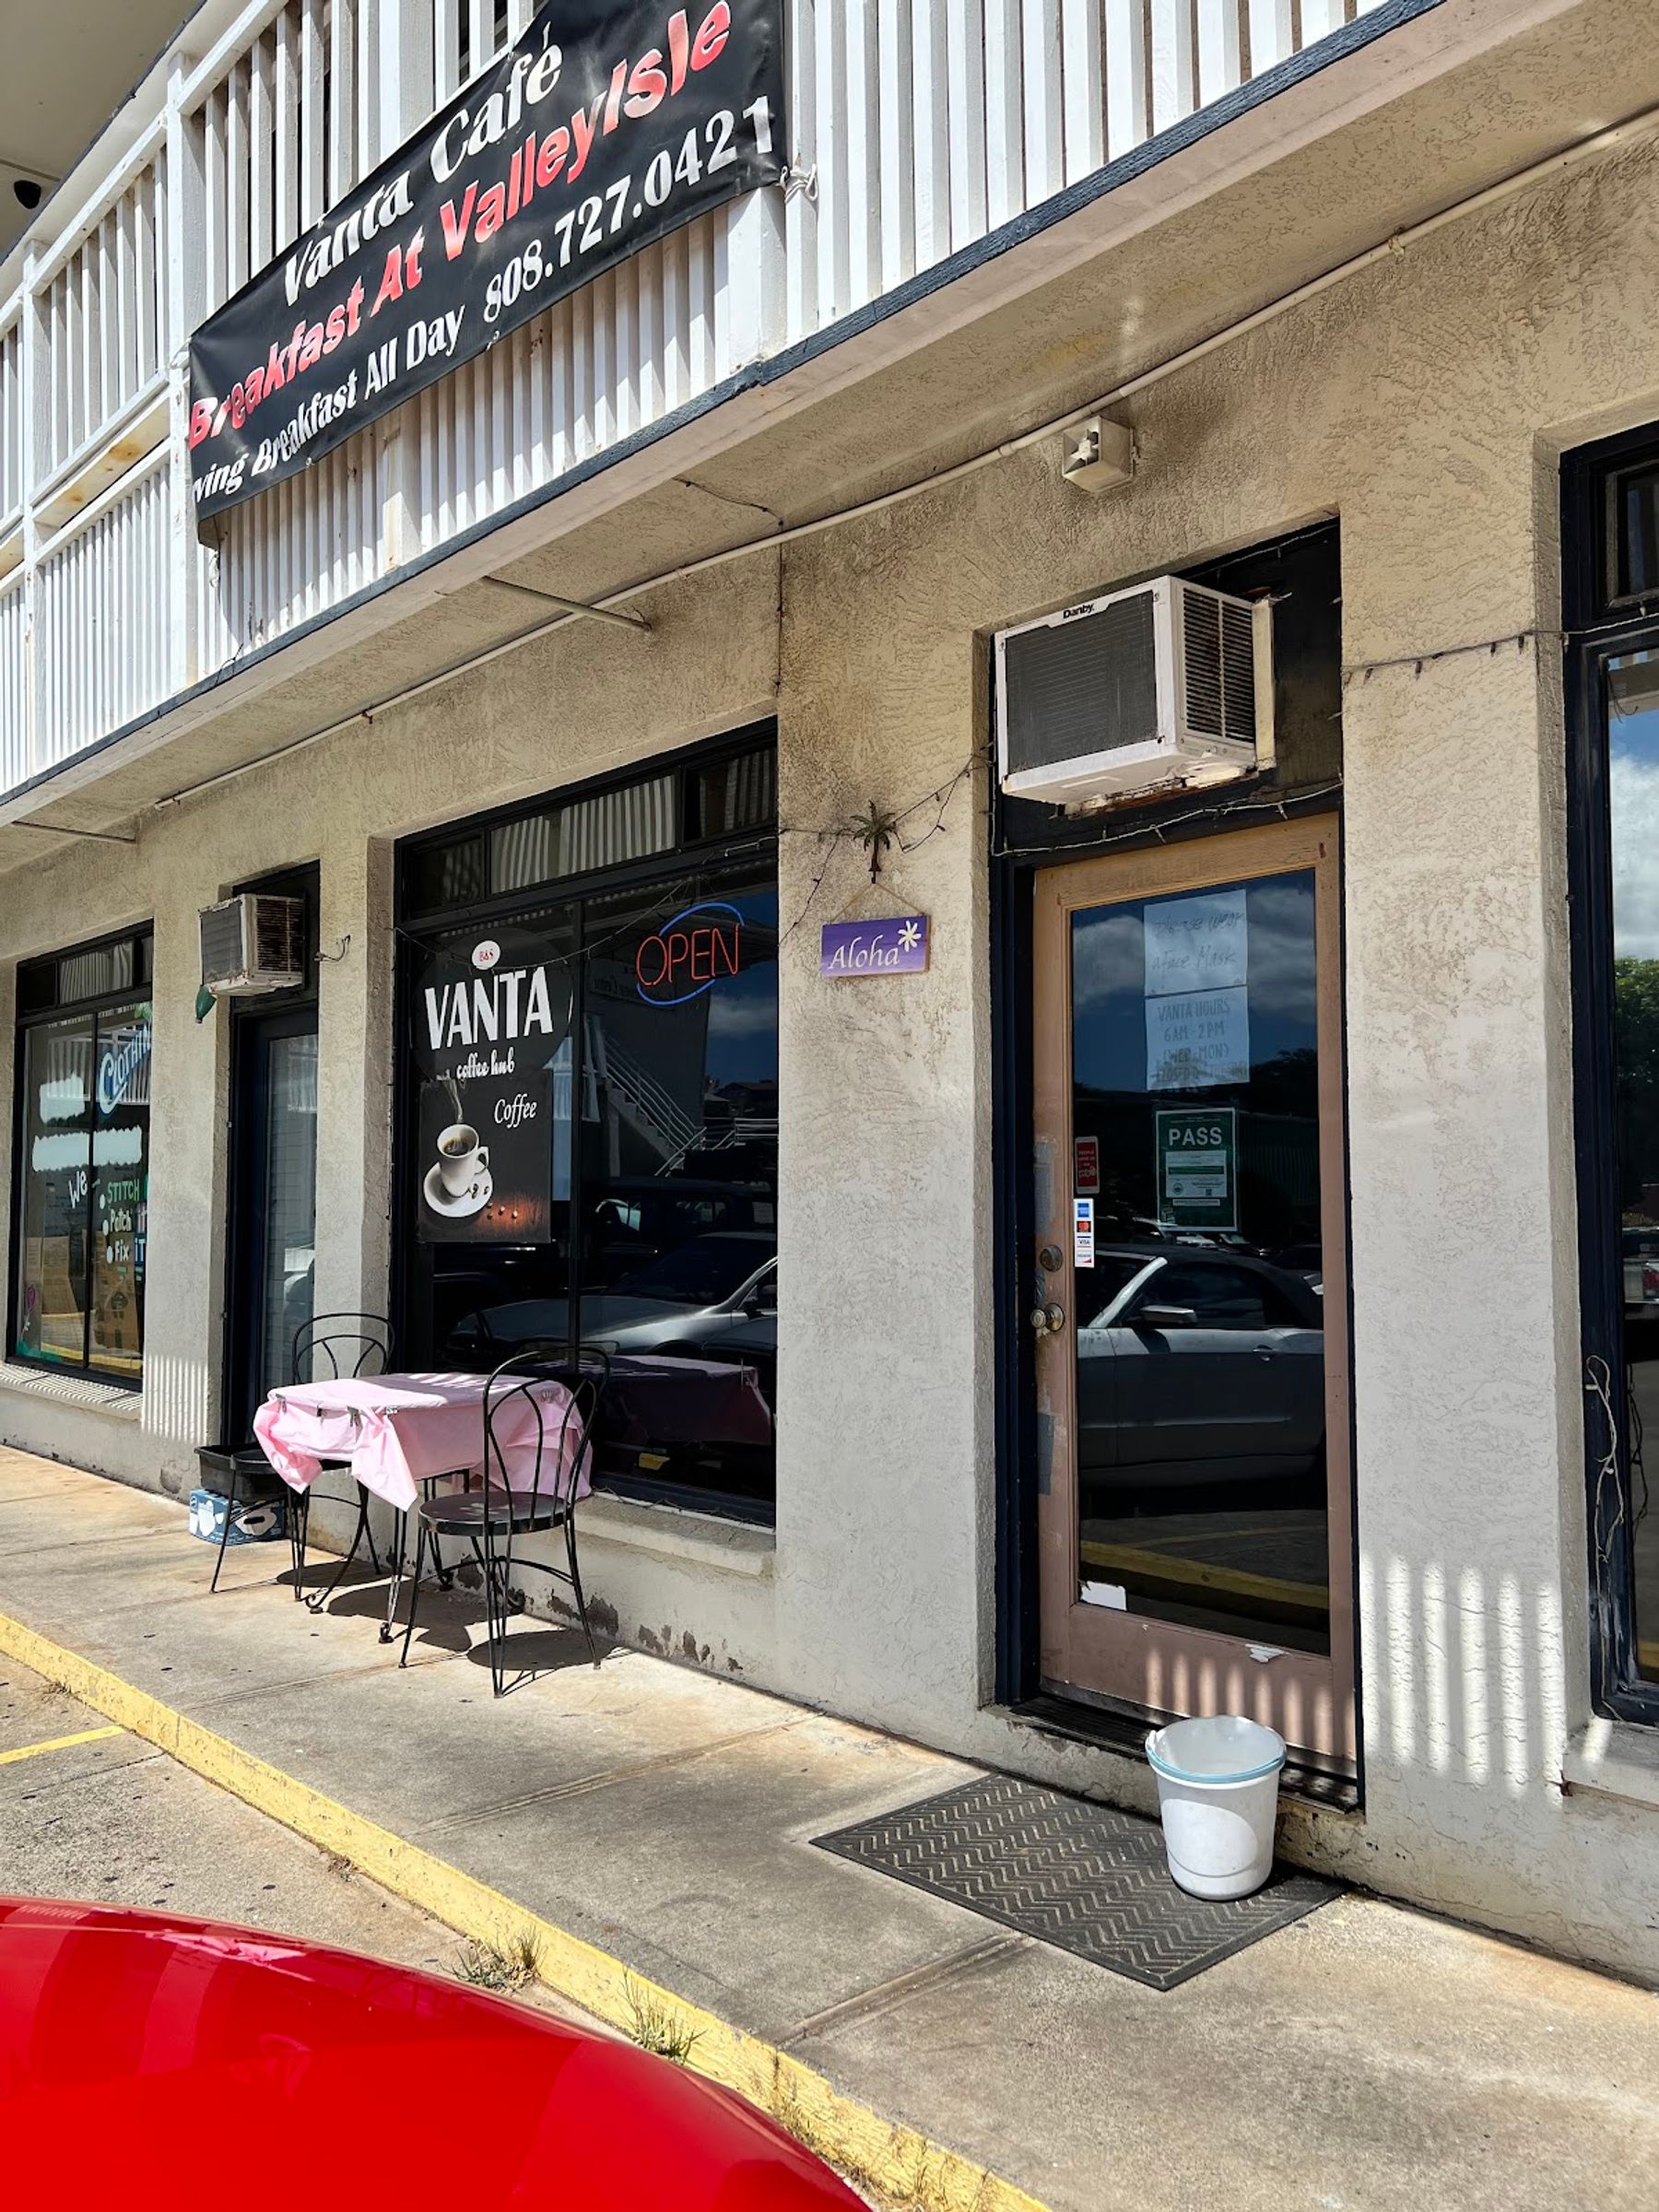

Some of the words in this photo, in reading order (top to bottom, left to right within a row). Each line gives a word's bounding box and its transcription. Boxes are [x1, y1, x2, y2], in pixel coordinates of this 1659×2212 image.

[285, 171, 414, 306] Vanta
[430, 20, 562, 183] Café
[193, 453, 249, 503] ving
[251, 369, 358, 477] Breakfast
[365, 337, 397, 400] All
[406, 304, 465, 371] Day
[484, 95, 772, 323] 808.727.0421
[189, 276, 364, 450] Breakfast
[370, 225, 425, 317] At
[1063, 604, 1093, 618] Danby
[636, 924, 740, 986] OPEN
[829, 935, 900, 970] Aloha
[424, 966, 554, 1051] VANTA
[1158, 1002, 1193, 1022] VANTA
[1195, 997, 1230, 1018] HOURS
[456, 1052, 489, 1080] coffee
[491, 1047, 515, 1076] hub
[494, 1093, 537, 1128] Coffee
[1169, 1126, 1222, 1146] PASS
[68, 1171, 88, 1209] We
[108, 1179, 140, 1204] STITCH
